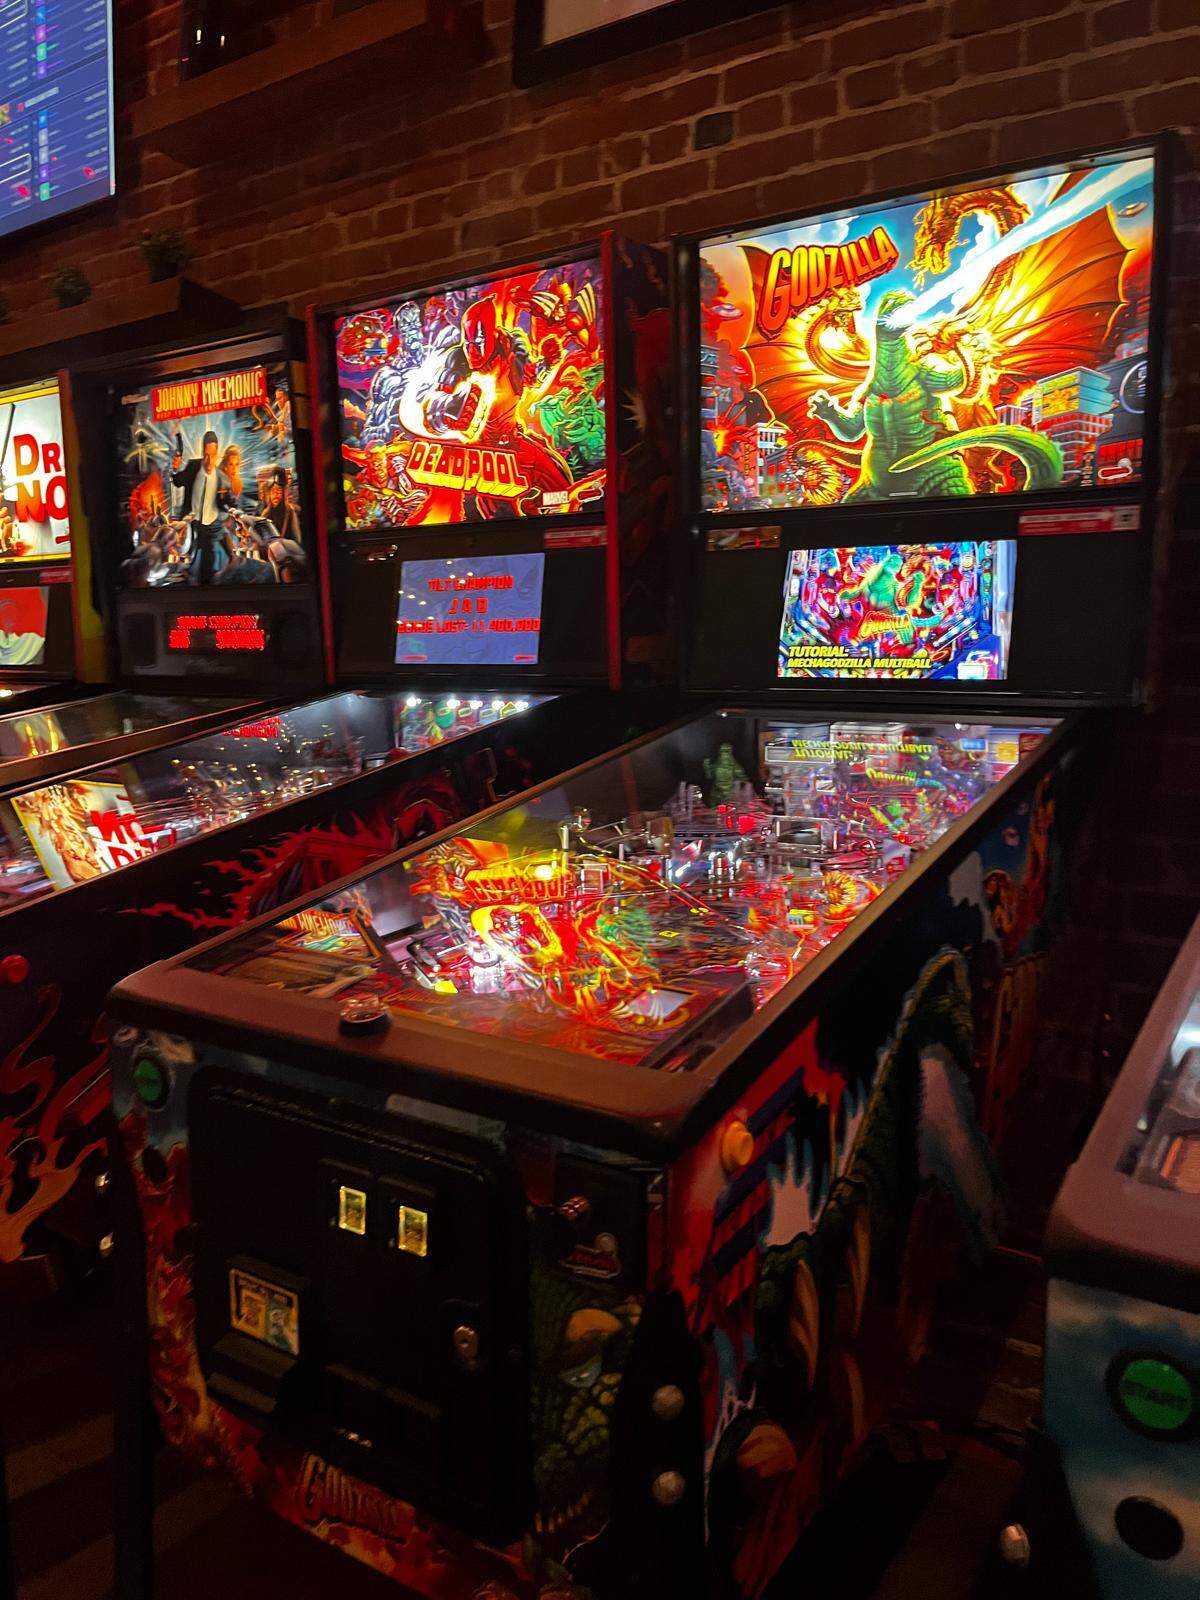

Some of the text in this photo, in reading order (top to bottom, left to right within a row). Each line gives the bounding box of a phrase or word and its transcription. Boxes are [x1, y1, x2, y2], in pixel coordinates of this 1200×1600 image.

[761, 226, 899, 334] GODZILLA
[155, 382, 199, 413] JOHNNY
[201, 371, 263, 406] MNEMONIC
[406, 441, 529, 496] DEADPOOL
[15, 475, 70, 524] NO
[787, 658, 932, 669] MECHAGODZILLA MULTIBALL
[788, 645, 849, 658] TUTORIAL:
[299, 1452, 416, 1546] GODZ
